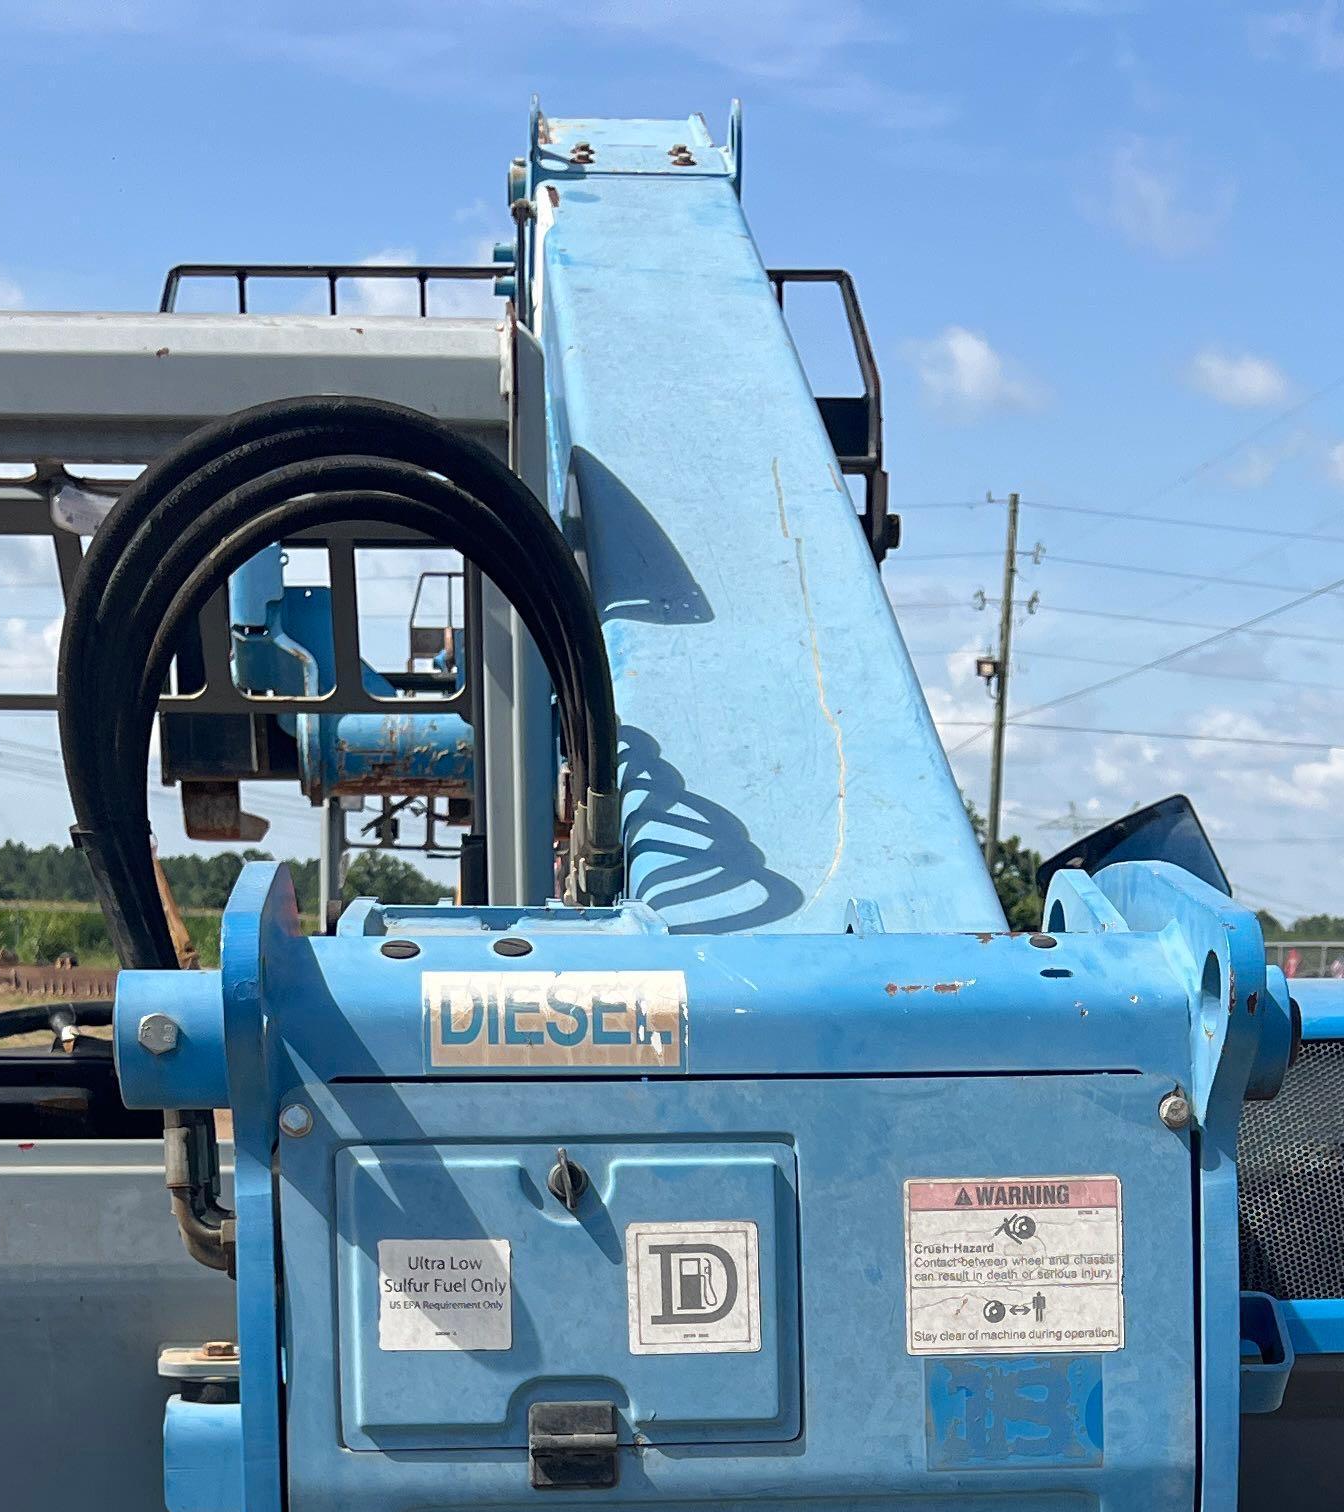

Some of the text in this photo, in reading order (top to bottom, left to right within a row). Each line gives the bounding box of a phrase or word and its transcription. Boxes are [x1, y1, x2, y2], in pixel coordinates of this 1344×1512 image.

[440, 984, 673, 1046] DIESEL
[975, 1184, 1070, 1206] WARNING
[914, 1243, 995, 1254] Crush Hazard
[408, 1256, 482, 1270] Ultra Low
[914, 1254, 1115, 1268] Contact between wheel and chassis
[914, 1273, 934, 1281] can
[938, 1270, 969, 1281] result
[973, 1270, 983, 1280] in
[987, 1269, 1018, 1280] death
[1021, 1271, 1033, 1280] or
[1037, 1268, 1077, 1279] serious
[384, 1278, 507, 1296] Sulfur Fuel Only
[389, 1301, 402, 1309] US
[423, 1301, 481, 1311] Requirement
[482, 1301, 504, 1311] Only
[914, 1328, 1118, 1343] Stay clear of machine during operation.
